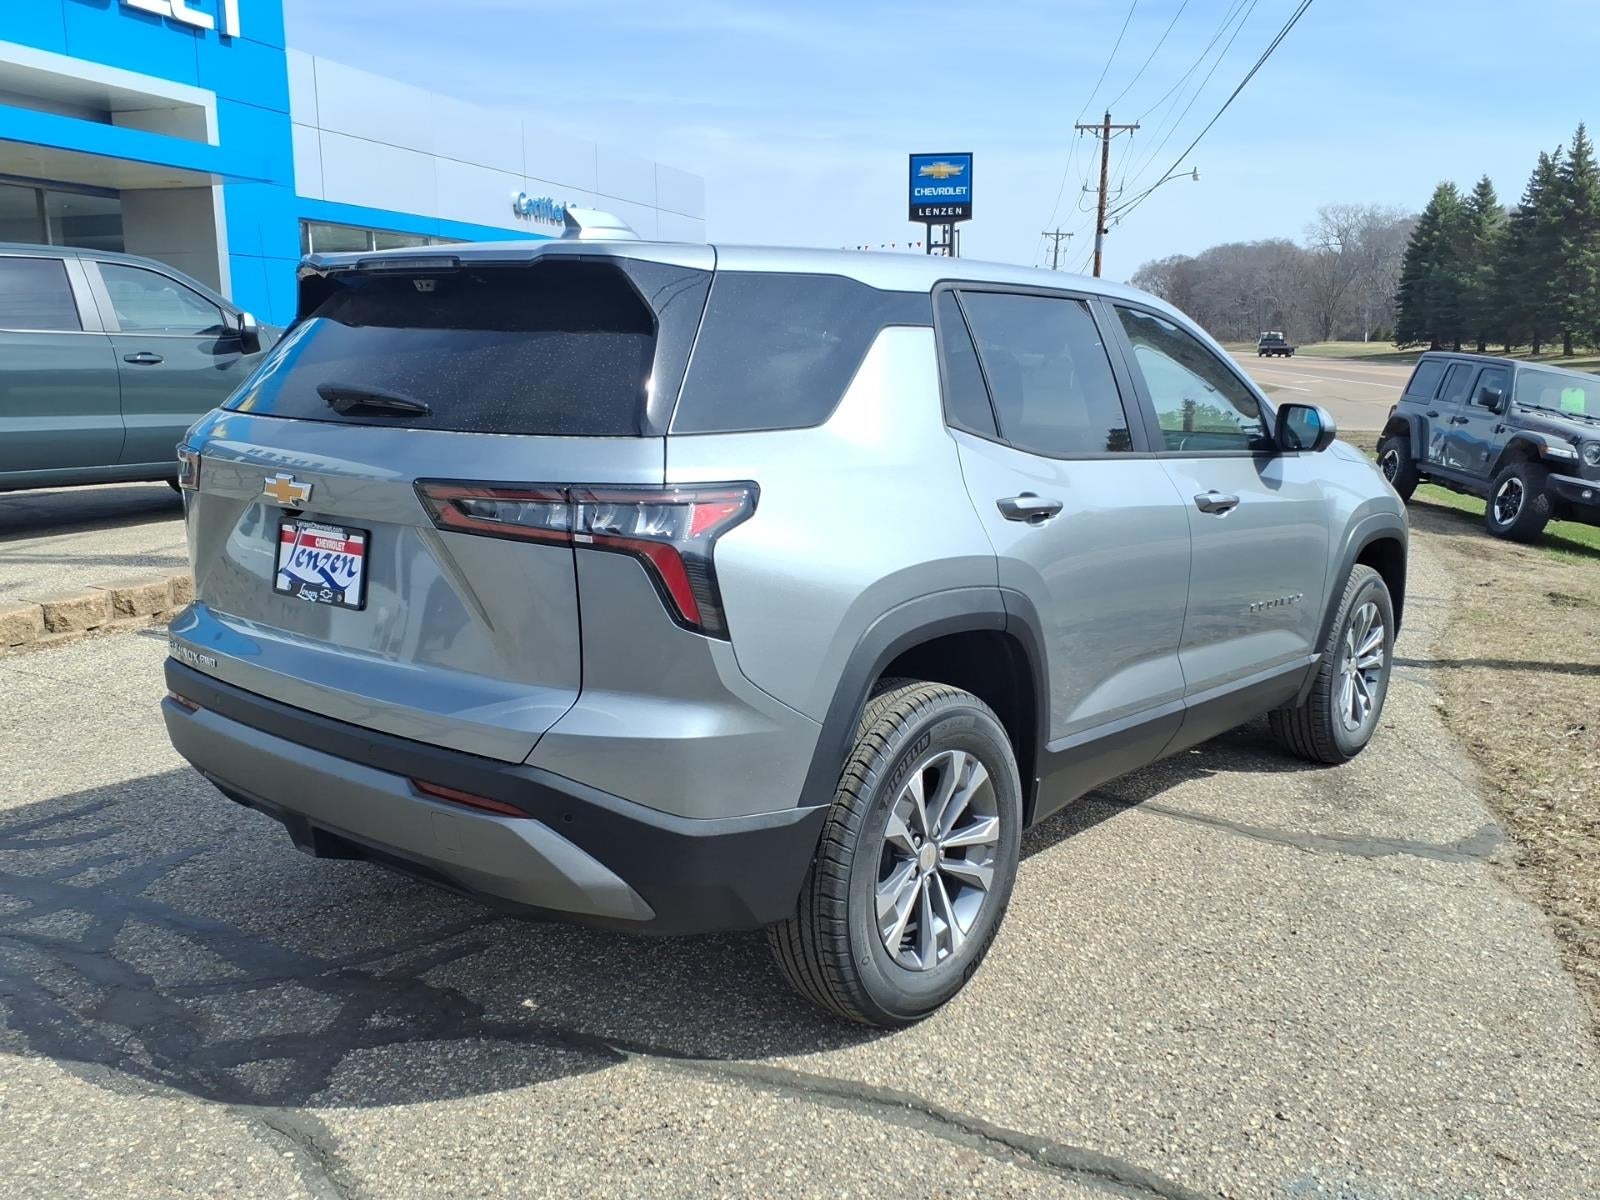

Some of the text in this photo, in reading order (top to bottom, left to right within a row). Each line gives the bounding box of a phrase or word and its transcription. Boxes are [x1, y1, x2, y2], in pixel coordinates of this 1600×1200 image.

[914, 186, 968, 196] CHEVROLET
[918, 207, 962, 216] LENZEN
[315, 537, 346, 552] CHEVROLET
[279, 526, 358, 592] Lenzen
[883, 732, 930, 807] MICHELIN
